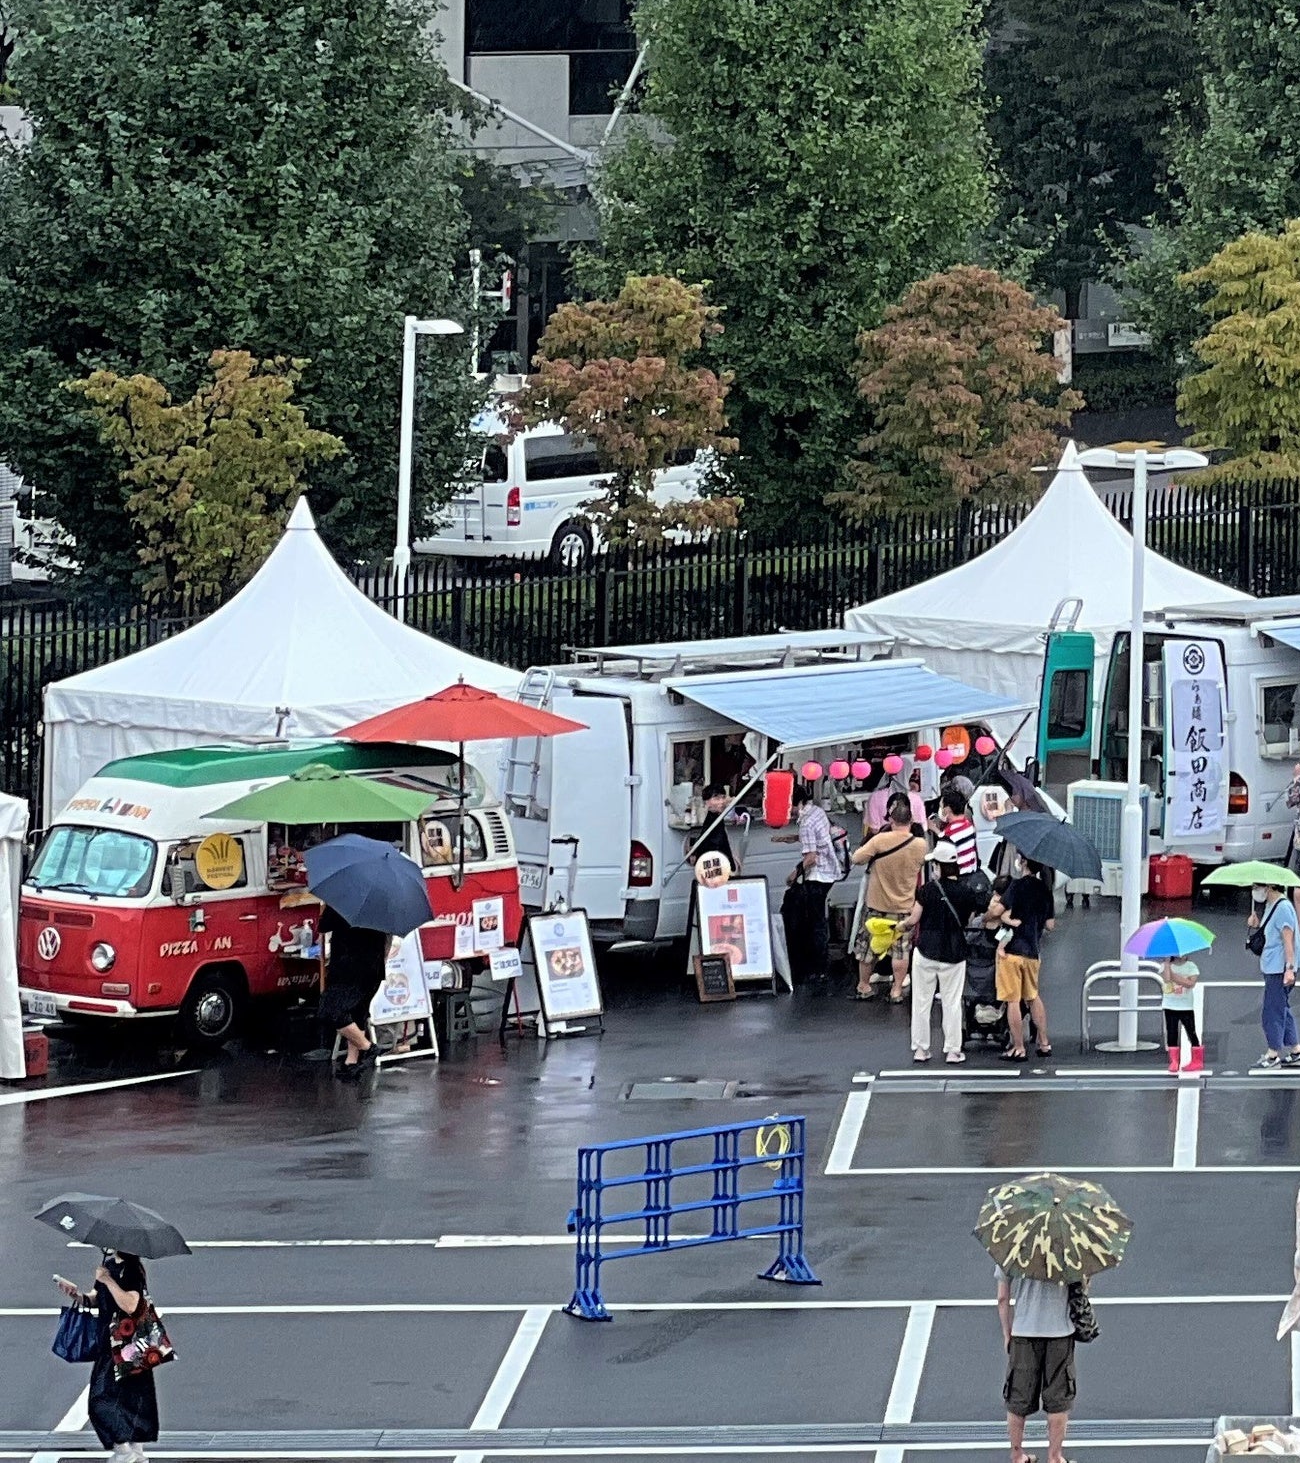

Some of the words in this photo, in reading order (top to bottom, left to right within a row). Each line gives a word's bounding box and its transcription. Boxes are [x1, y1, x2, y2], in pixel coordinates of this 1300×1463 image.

[1185, 725, 1211, 831] 飯田商店
[159, 940, 199, 957] PIZZA
[204, 936, 232, 951] VAN
